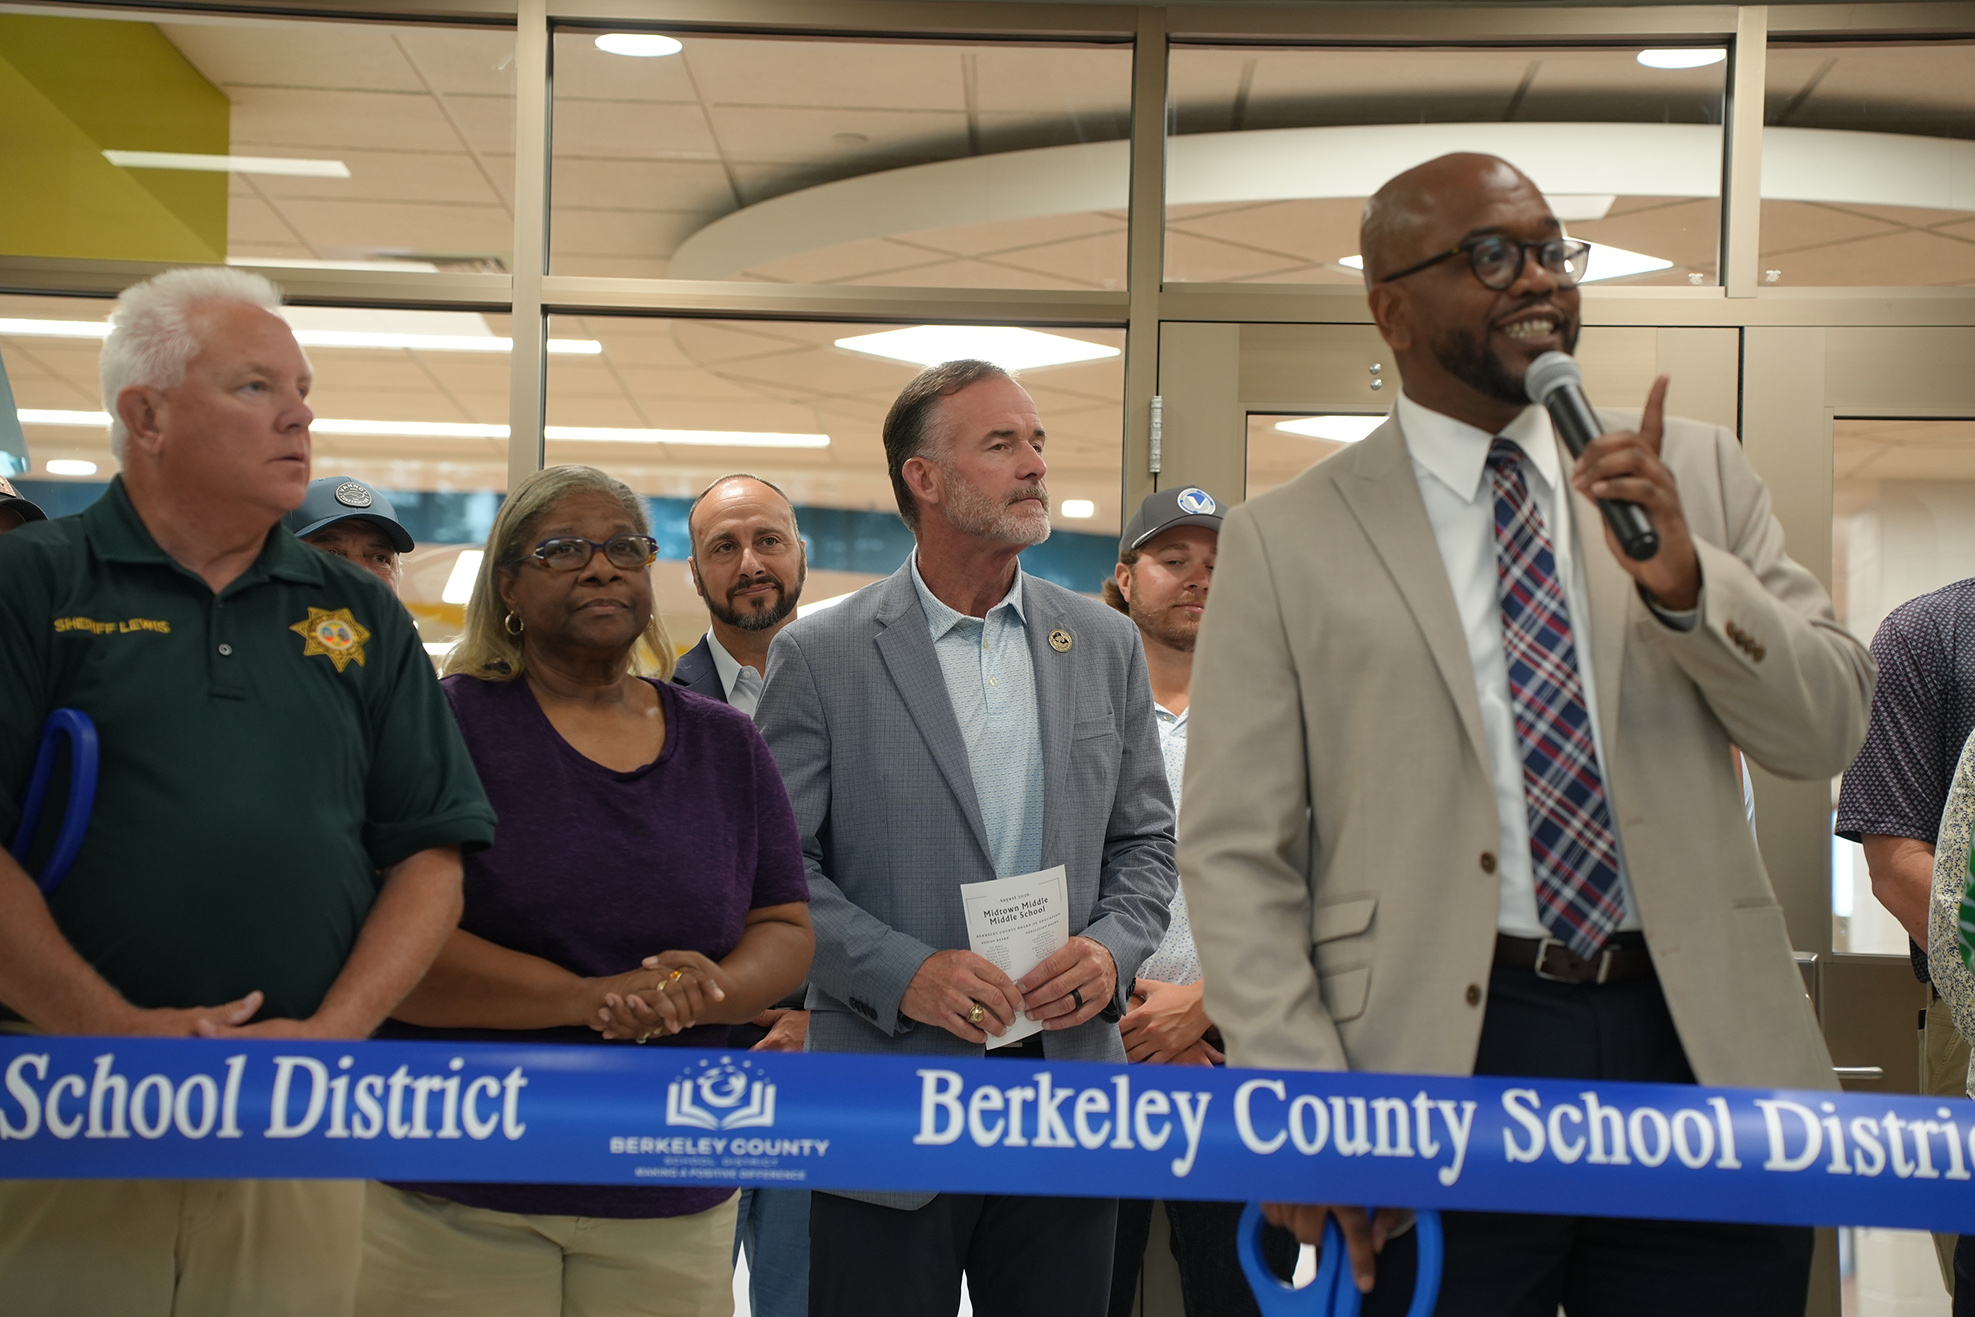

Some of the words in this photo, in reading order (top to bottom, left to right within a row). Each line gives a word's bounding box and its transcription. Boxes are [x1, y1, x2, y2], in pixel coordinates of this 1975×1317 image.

[53, 617, 117, 635] SHERIFF
[119, 617, 171, 634] LEWIS
[983, 905, 1020, 918] Midtown
[1021, 897, 1049, 910] Middle
[989, 914, 1018, 926] Middle
[1020, 905, 1046, 919] School
[0, 1053, 248, 1140] School
[263, 1054, 528, 1140] District
[913, 1068, 1213, 1178] Berkeley
[1233, 1078, 1478, 1187] County
[1501, 1087, 1743, 1170] School
[1753, 1098, 1975, 1181] Distri
[609, 1136, 728, 1155] BERKELEY
[730, 1137, 831, 1157] COUNTY
[738, 1169, 807, 1181] DIFFERENCE
